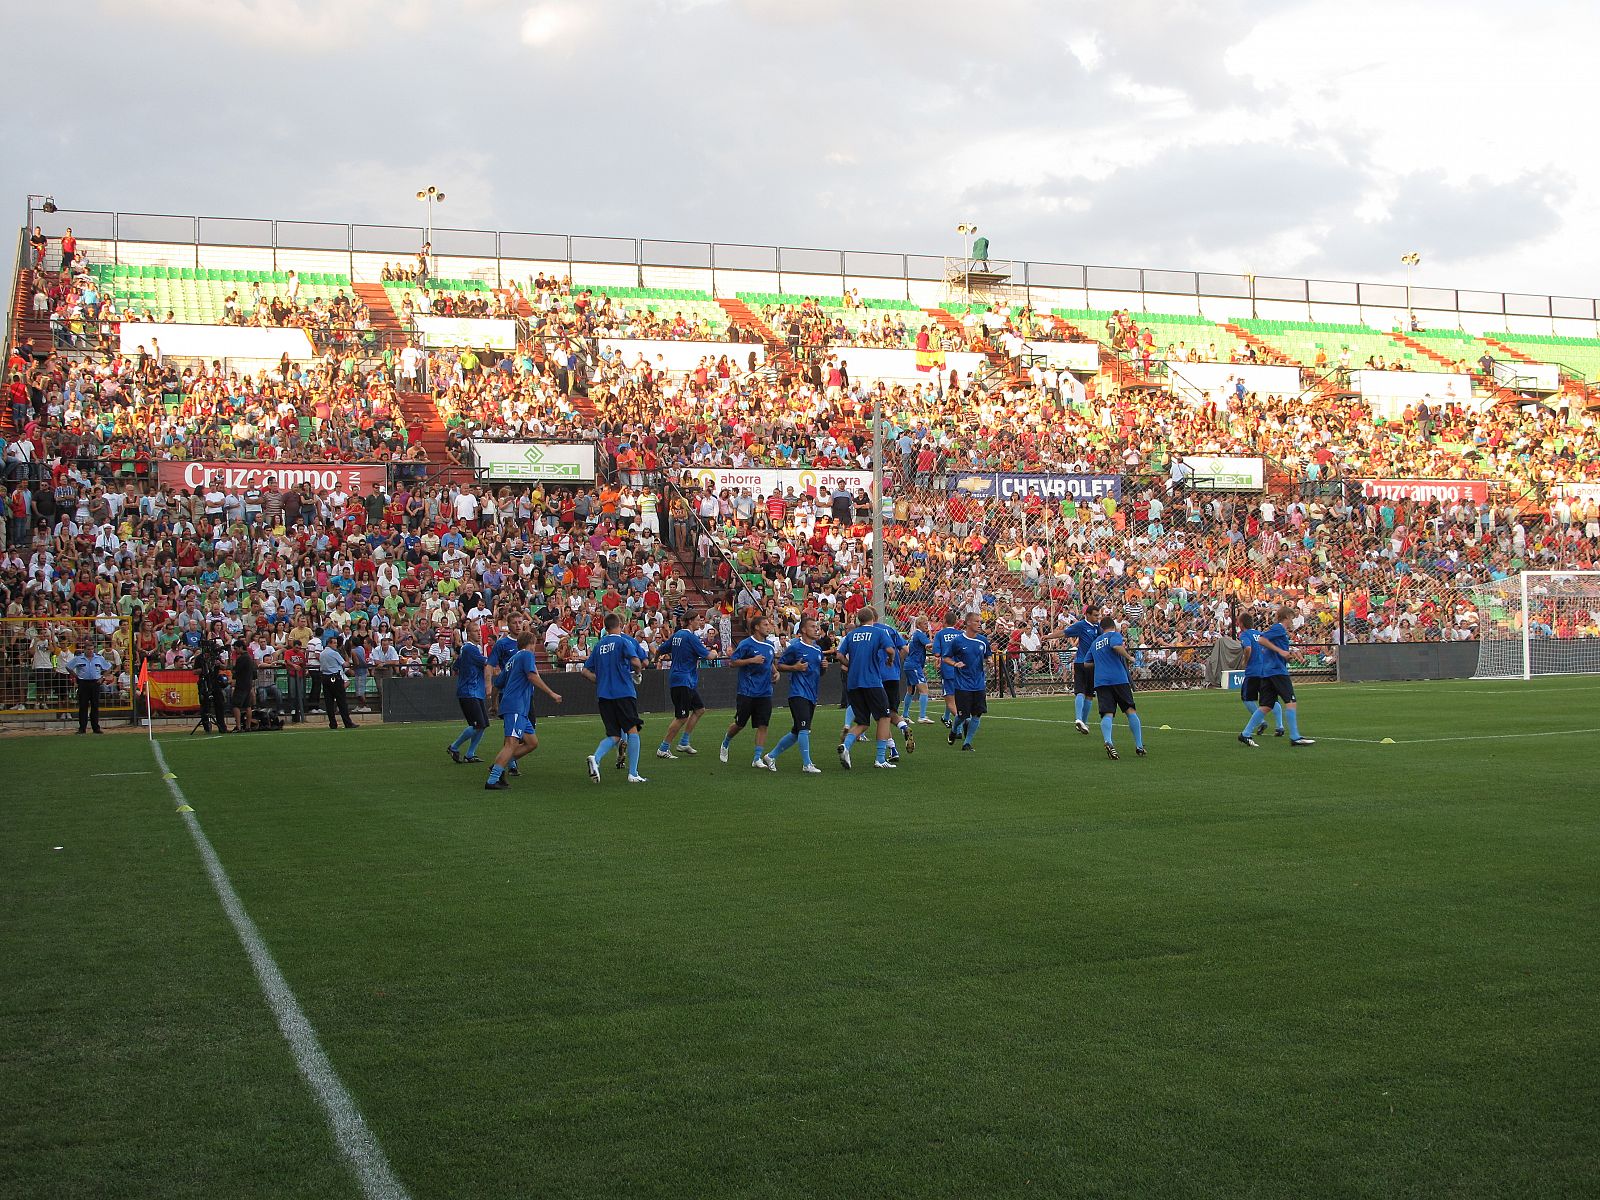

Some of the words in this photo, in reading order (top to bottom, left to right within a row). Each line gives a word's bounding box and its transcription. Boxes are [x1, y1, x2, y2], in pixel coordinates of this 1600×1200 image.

[184, 462, 338, 490] Cruzcampo
[720, 472, 762, 485] ahorra
[1001, 478, 1115, 497] CHEVROLET
[1361, 480, 1459, 503] Cruzcampo
[852, 631, 873, 642] EESTI
